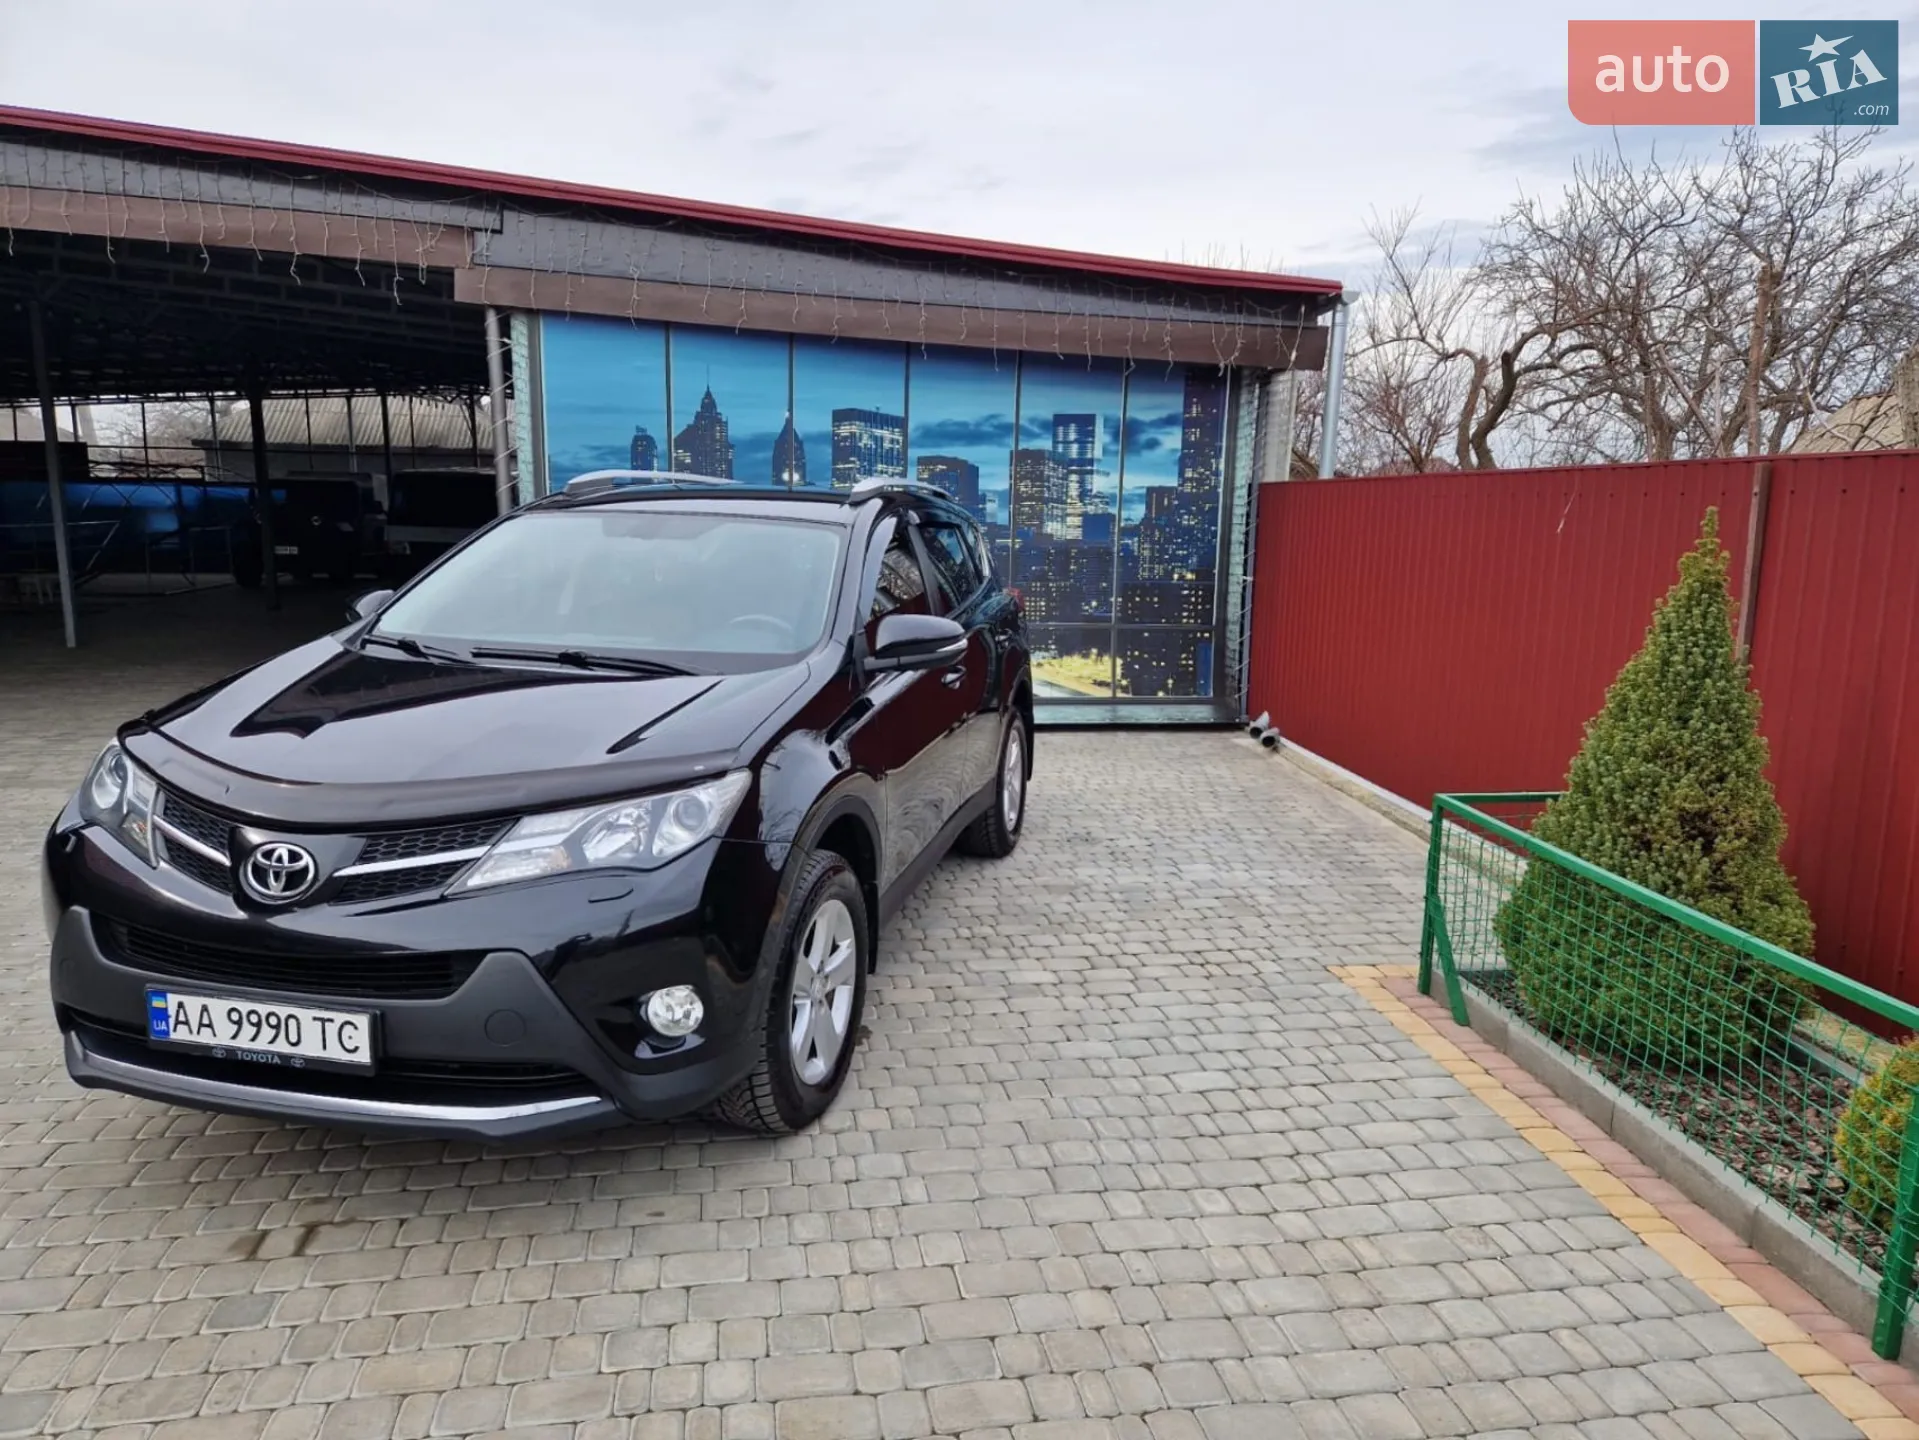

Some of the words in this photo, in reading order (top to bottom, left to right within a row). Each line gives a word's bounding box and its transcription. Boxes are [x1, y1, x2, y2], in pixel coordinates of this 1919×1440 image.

[153, 1021, 168, 1031] UA
[172, 1000, 217, 1038] AA
[226, 1006, 302, 1048] 9990
[312, 1016, 361, 1055] TC
[236, 1050, 281, 1065] TOYOTA
